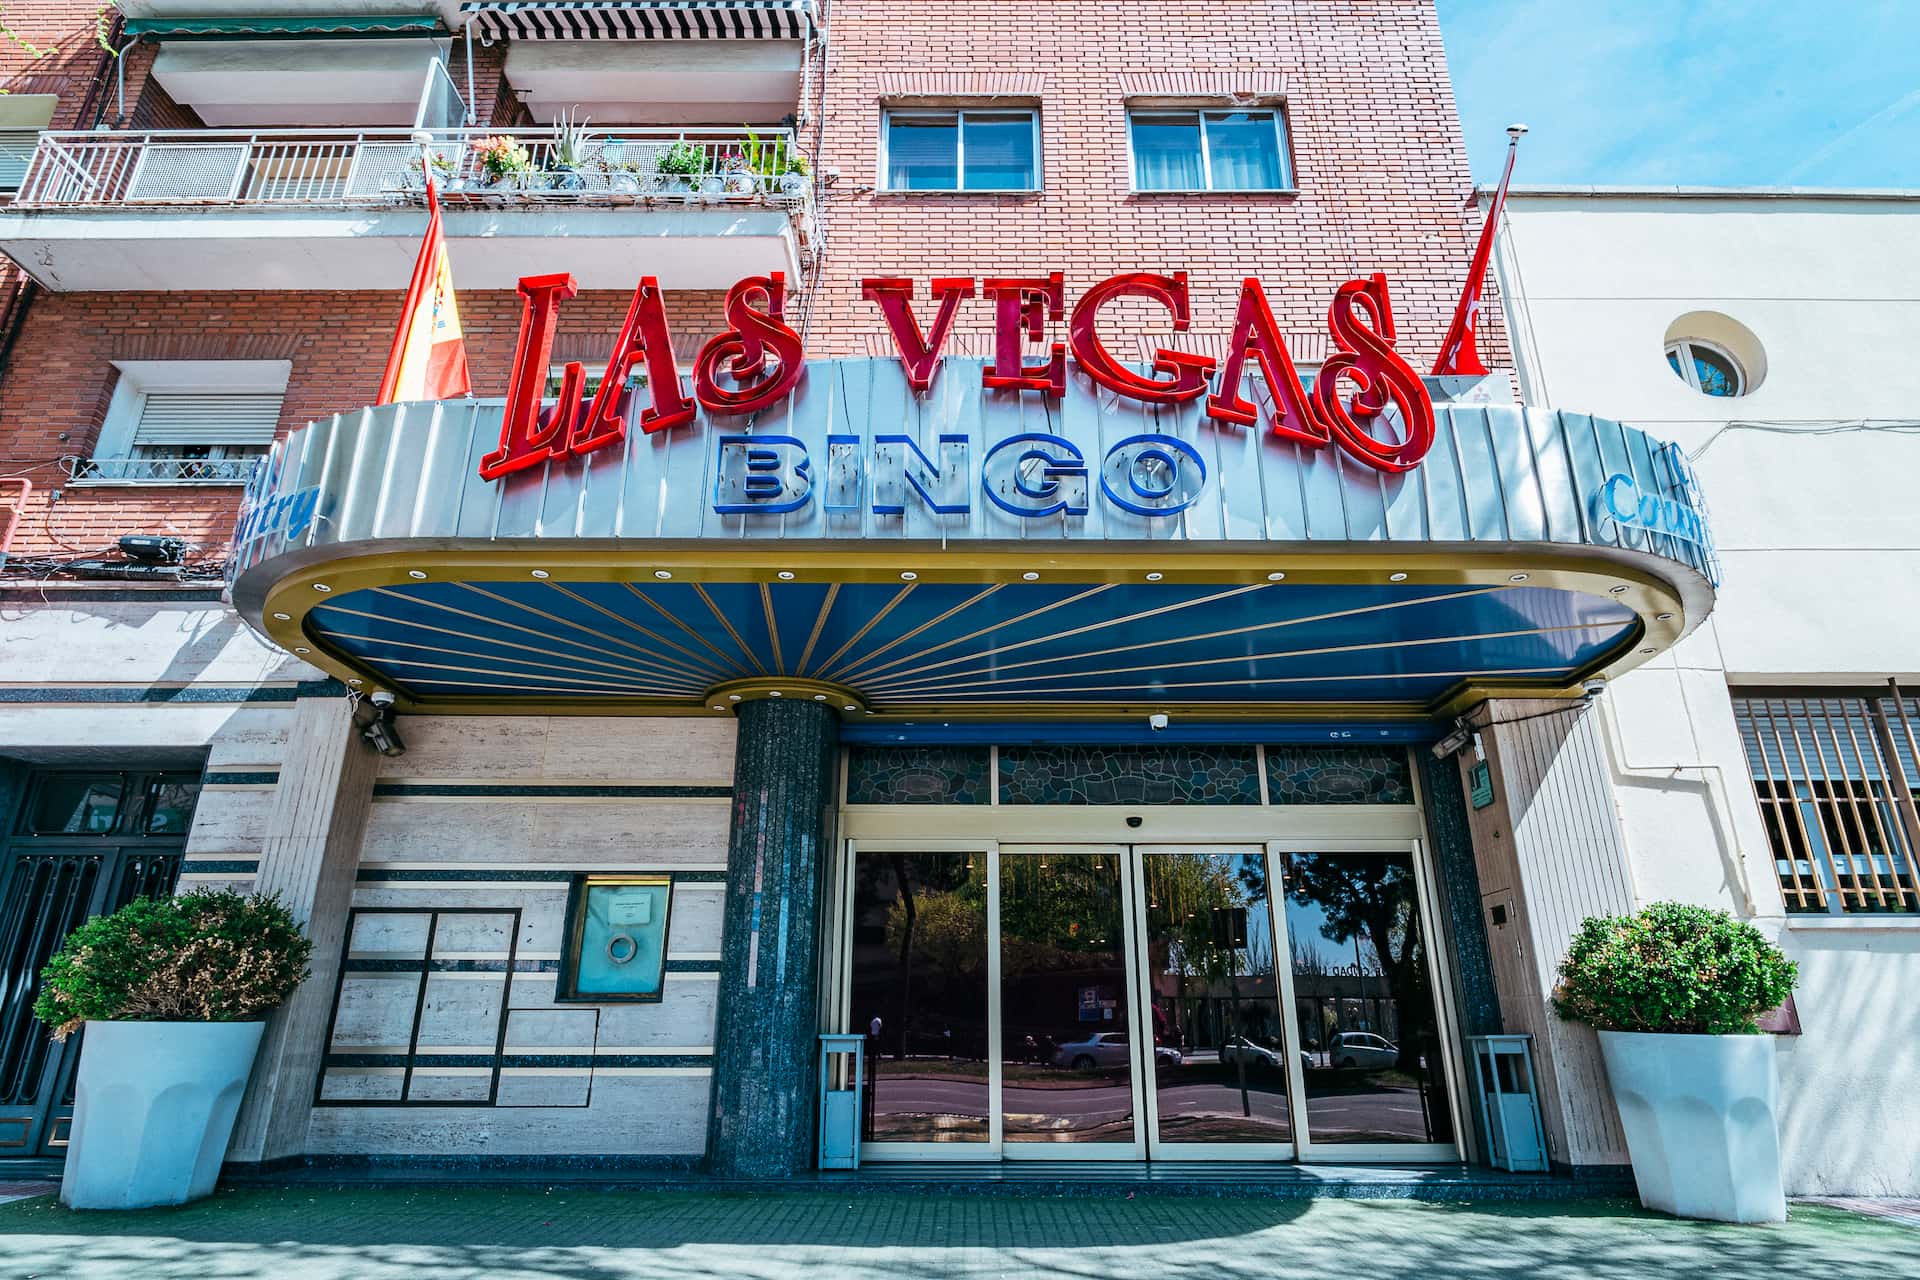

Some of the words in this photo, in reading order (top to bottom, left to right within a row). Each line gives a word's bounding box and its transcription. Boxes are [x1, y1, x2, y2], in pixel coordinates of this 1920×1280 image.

[479, 271, 806, 482] LAS
[862, 271, 1435, 473] VEGAS
[713, 433, 1207, 517] BINGO
